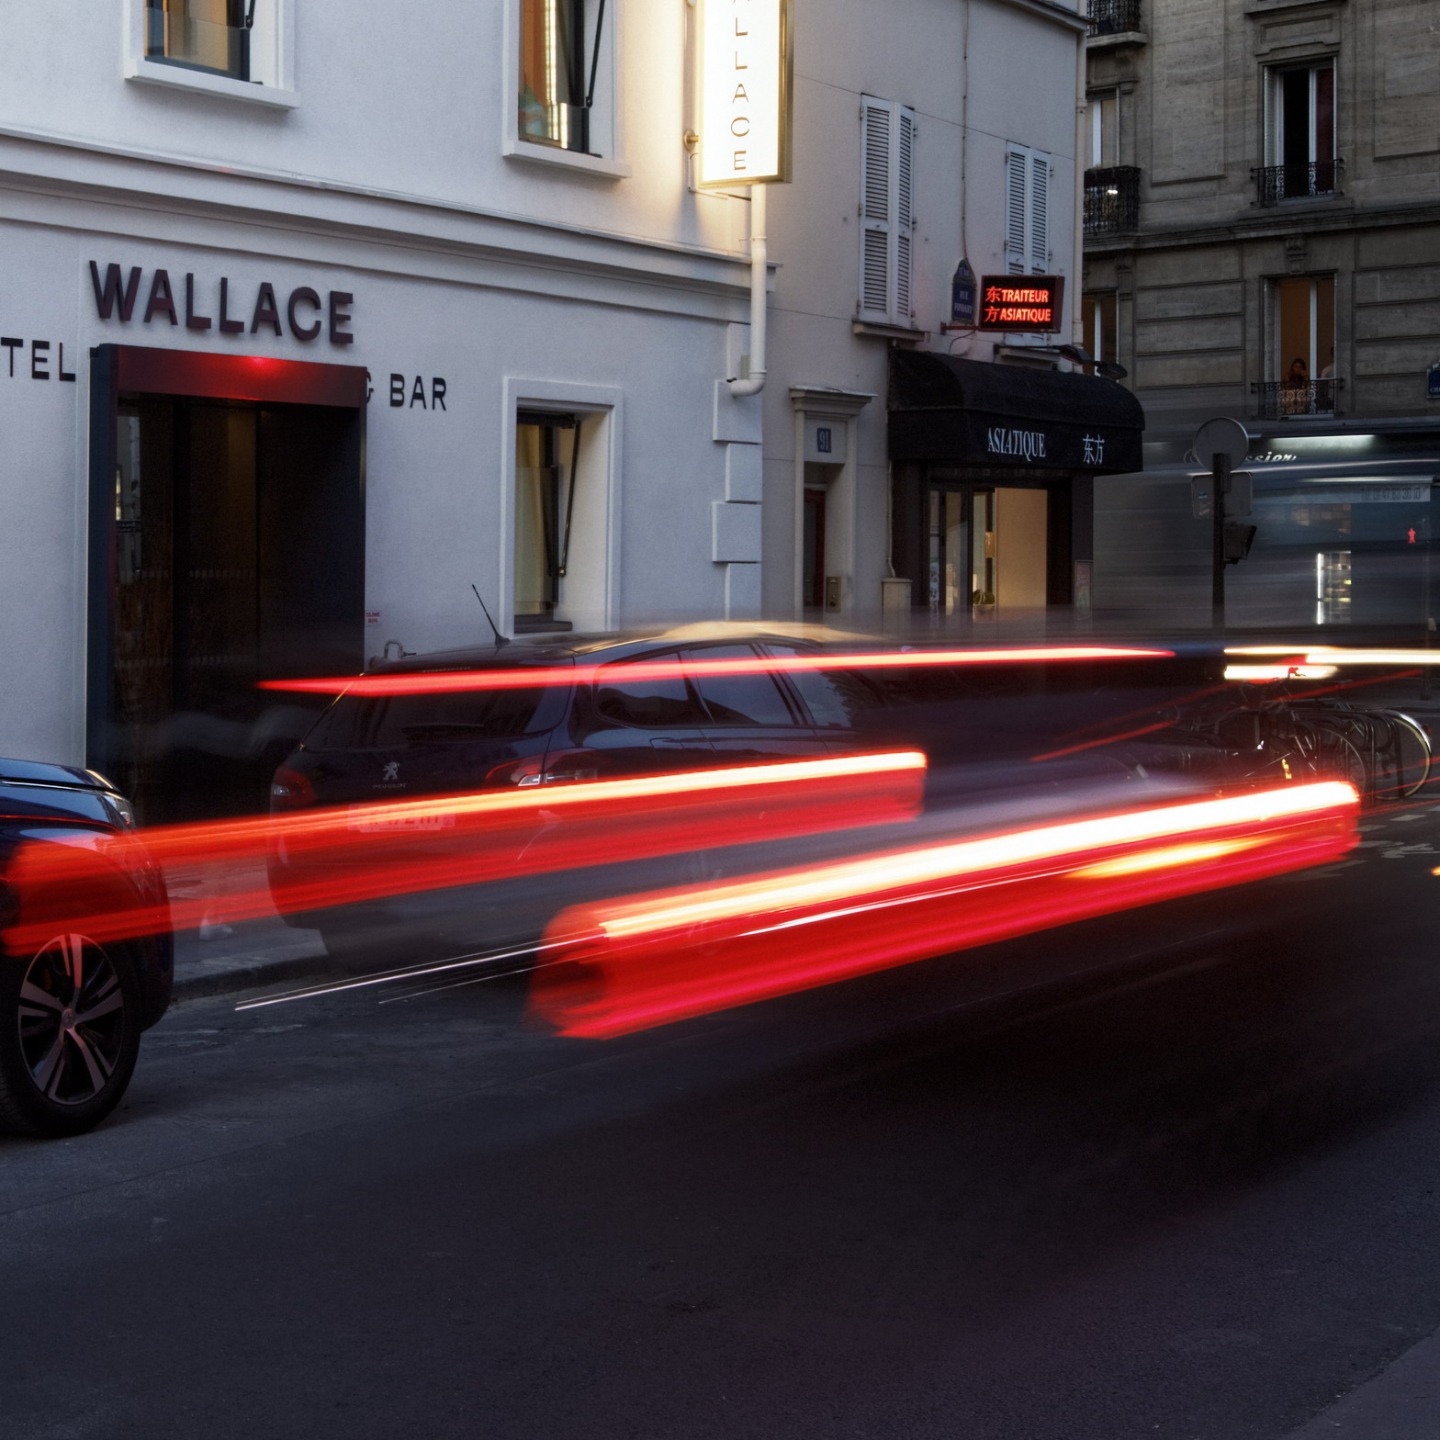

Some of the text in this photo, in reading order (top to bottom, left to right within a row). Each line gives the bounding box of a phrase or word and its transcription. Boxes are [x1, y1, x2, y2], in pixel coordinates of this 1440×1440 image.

[89, 260, 354, 346] WALLACE
[1001, 288, 1050, 304] TRAITEUR
[999, 307, 1052, 324] ASIATIQUE
[390, 373, 447, 411] BAR
[819, 430, 830, 451] 91
[987, 427, 1047, 462] ASIATIQUE
[1082, 432, 1105, 465] 东方
